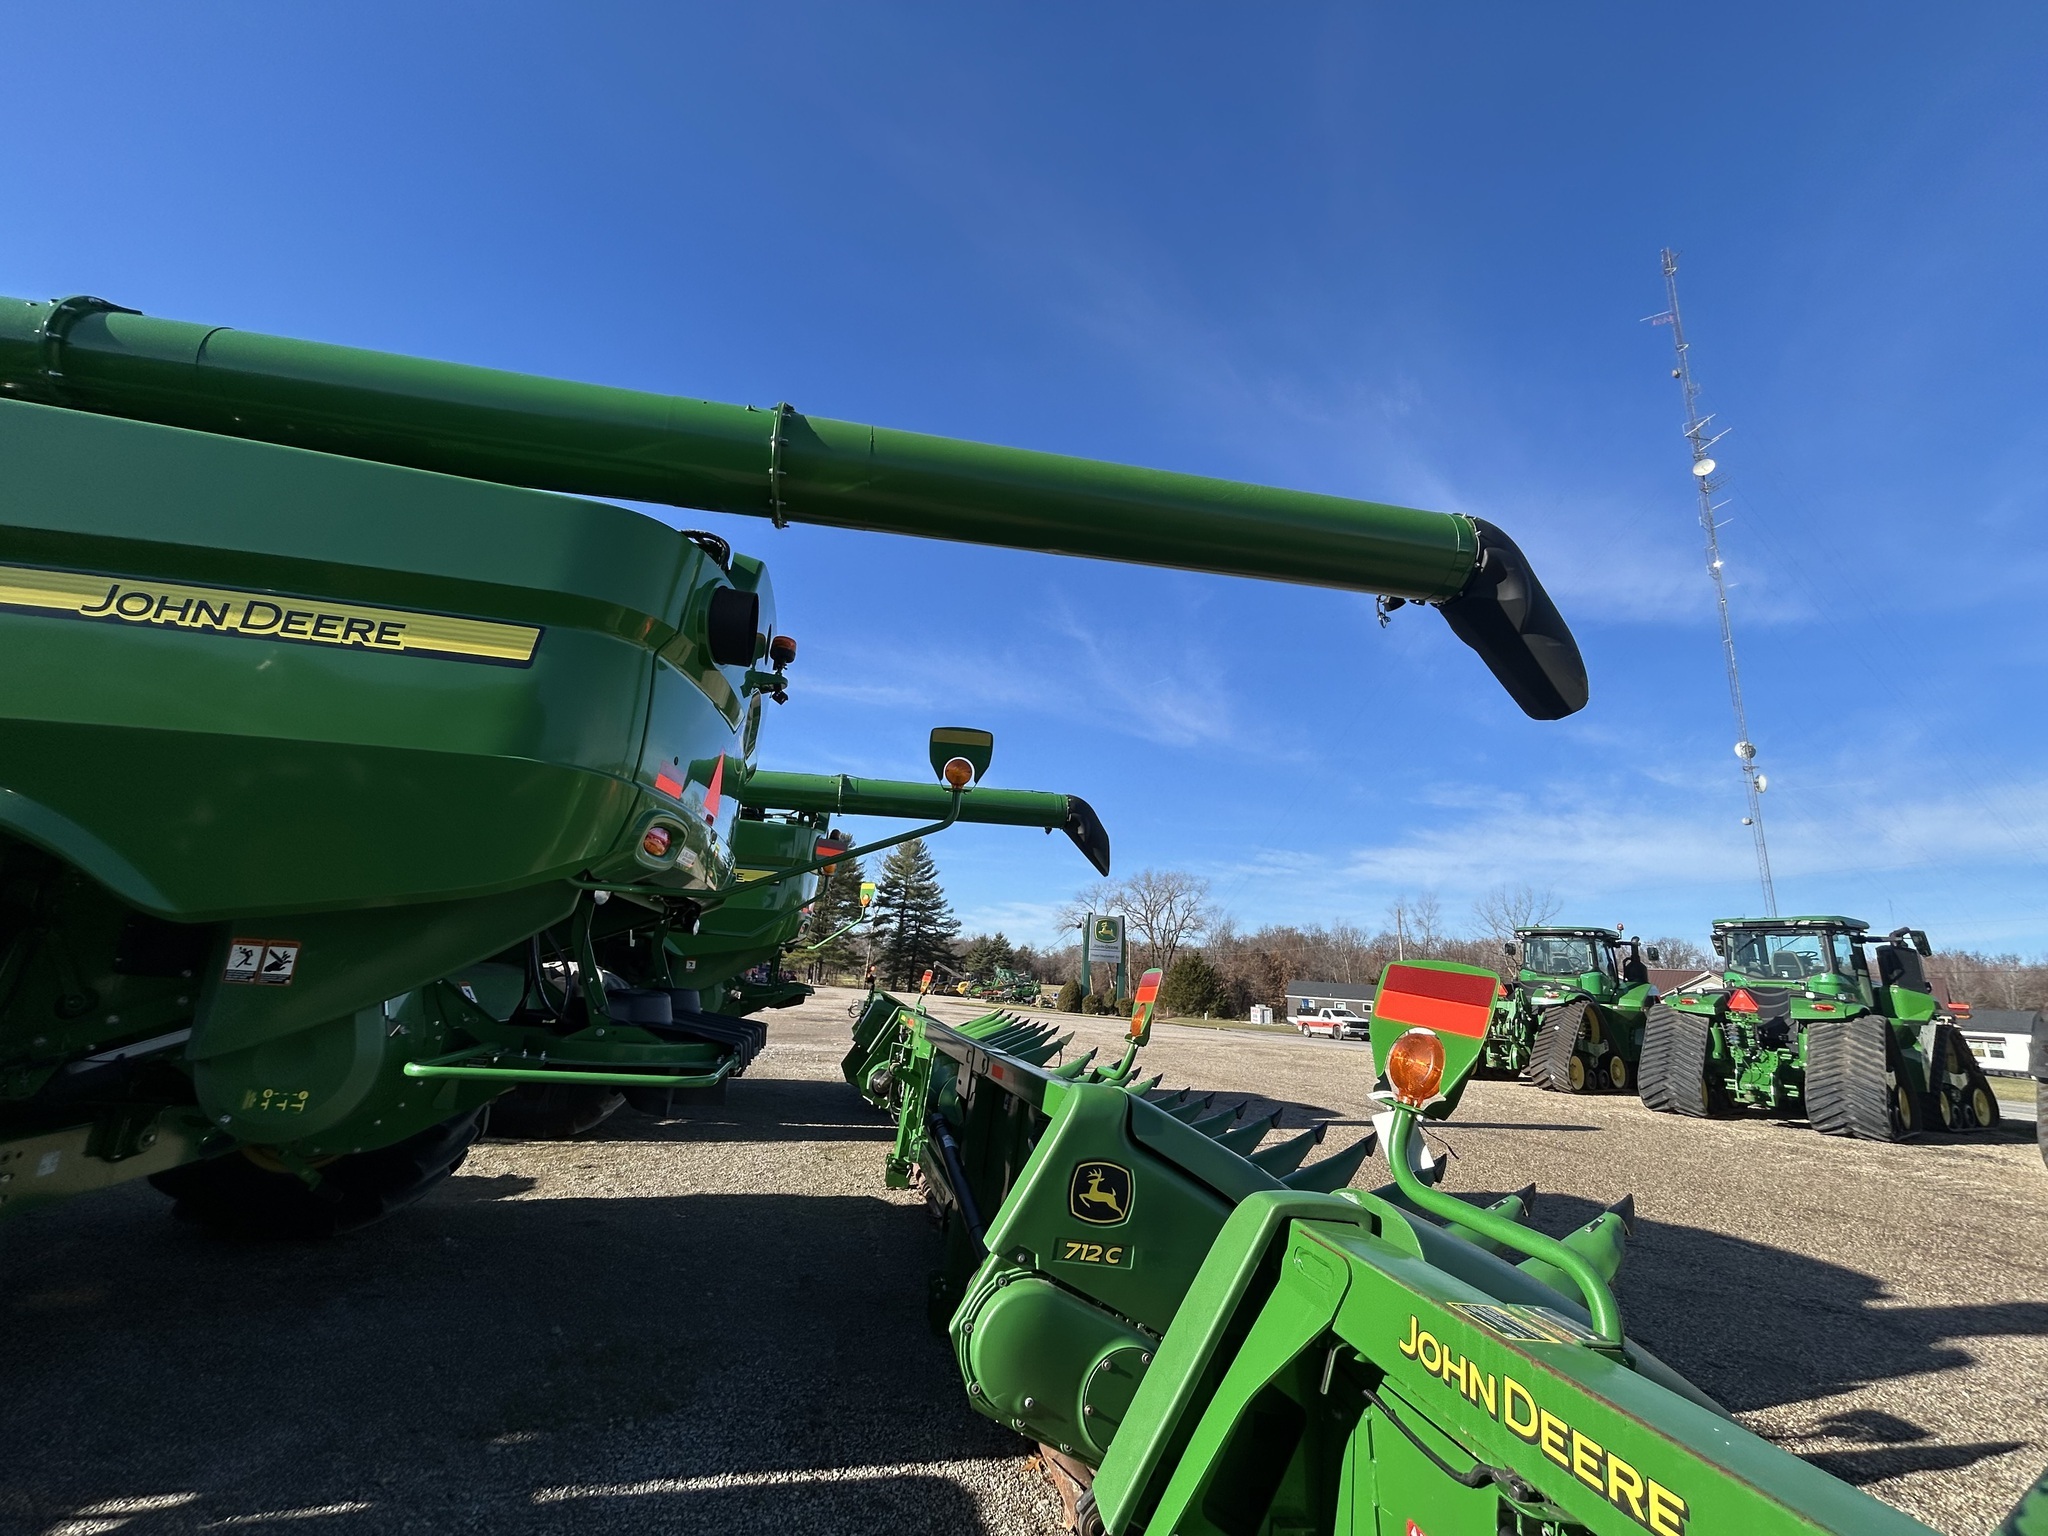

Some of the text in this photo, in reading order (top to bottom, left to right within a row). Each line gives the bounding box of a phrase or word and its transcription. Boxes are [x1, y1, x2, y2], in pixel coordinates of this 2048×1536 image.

[80, 584, 407, 646] JOHN DEERE
[1399, 1314, 1690, 1536] JOHN DEERE
